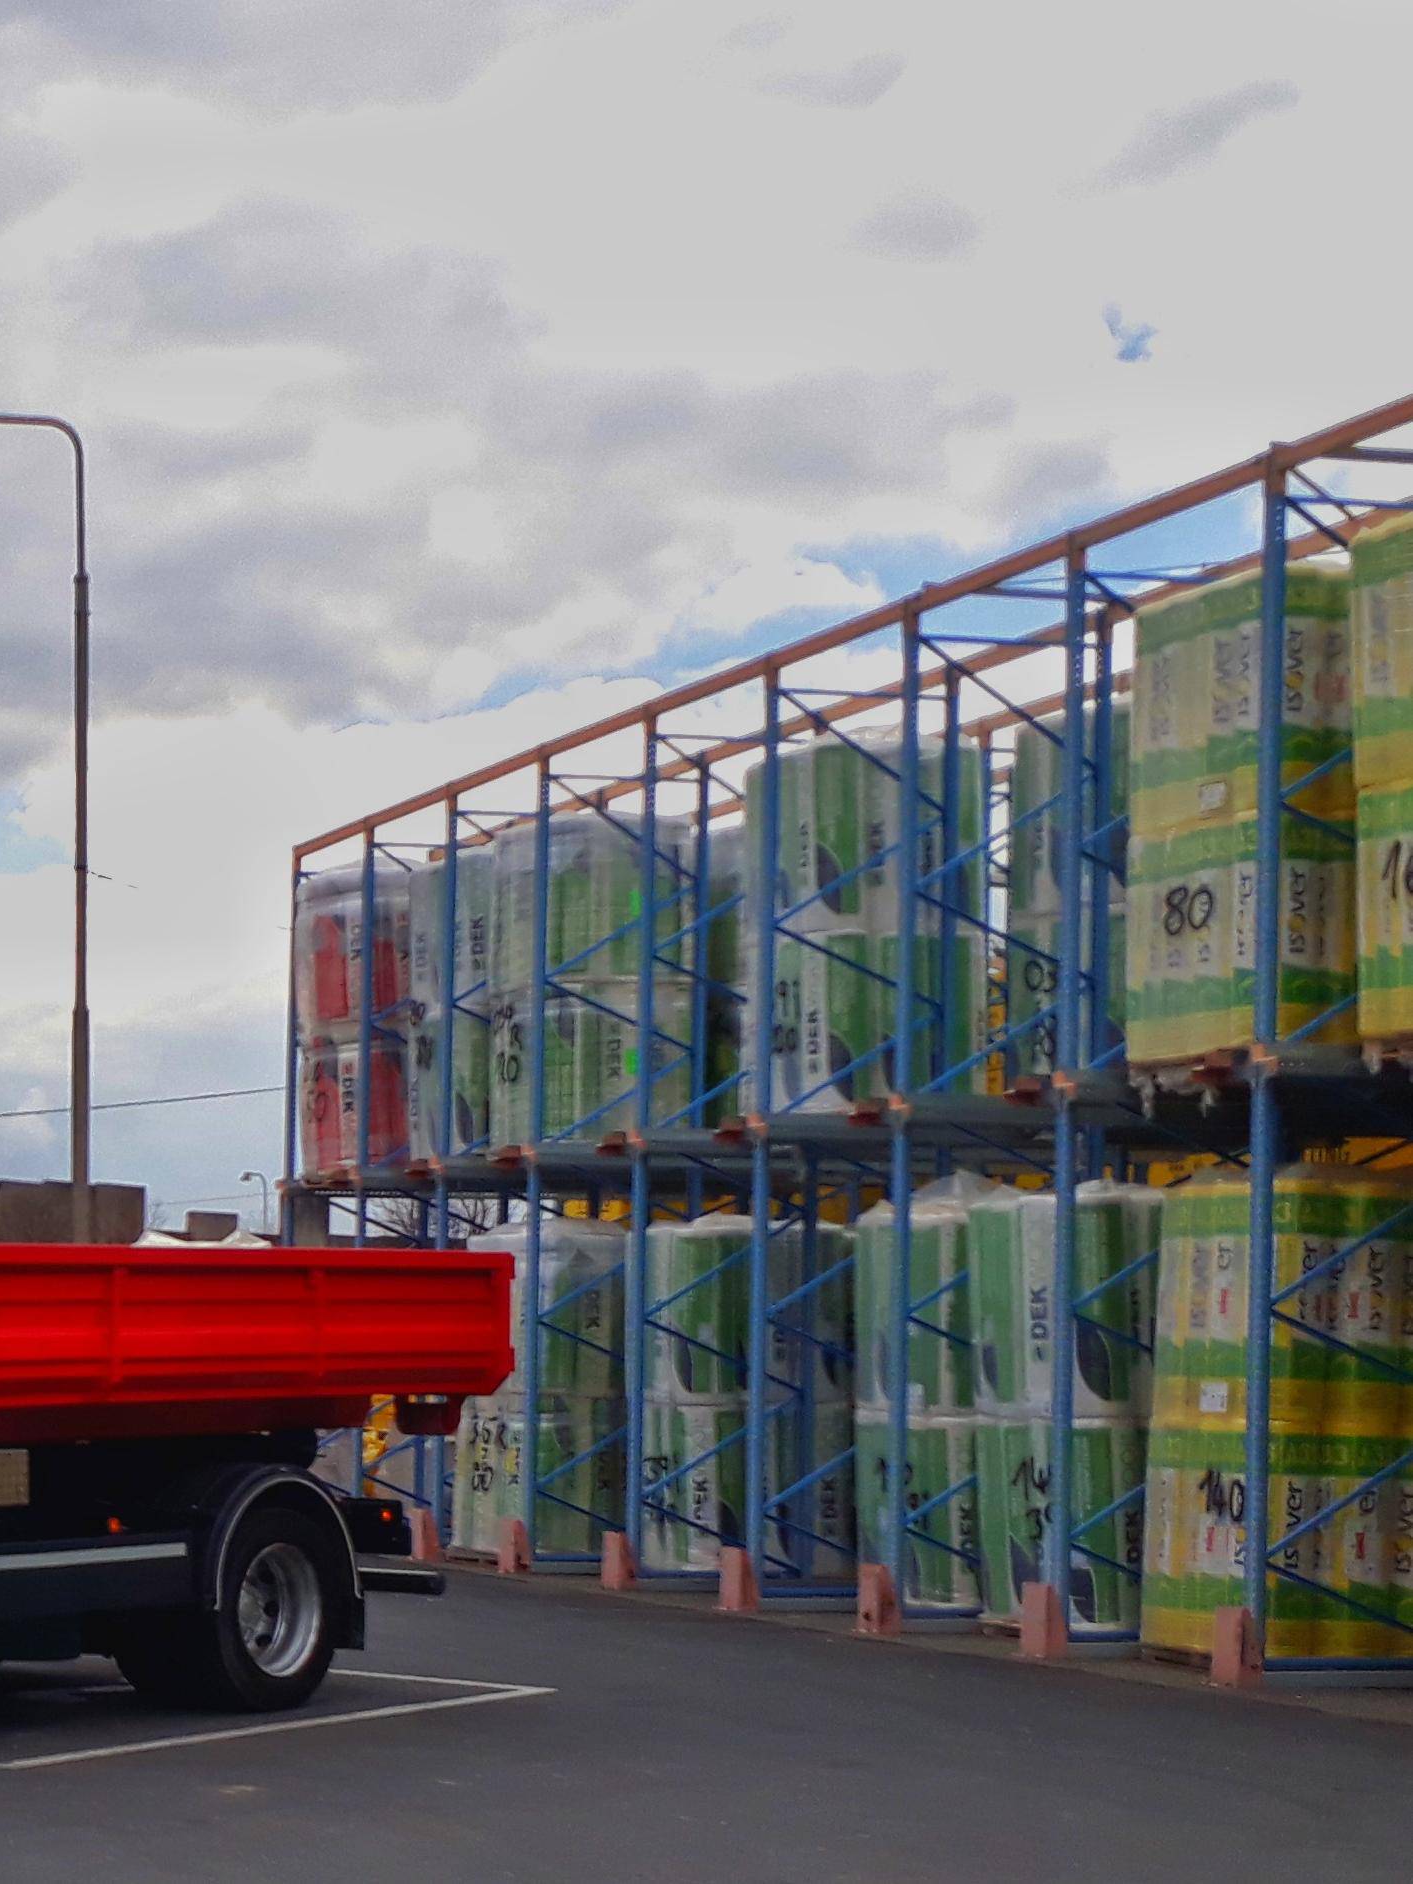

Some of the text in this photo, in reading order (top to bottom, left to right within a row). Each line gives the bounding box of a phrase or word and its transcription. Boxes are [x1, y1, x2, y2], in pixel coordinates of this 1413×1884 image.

[1164, 885, 1214, 936] 80
[1288, 866, 1306, 954] isover
[606, 1037, 622, 1080] DEK
[341, 1076, 356, 1114] DEK
[1030, 1285, 1048, 1340] DEK
[1368, 1246, 1384, 1331] isover
[1199, 1469, 1245, 1521] 140
[1284, 1481, 1302, 1569] isver
